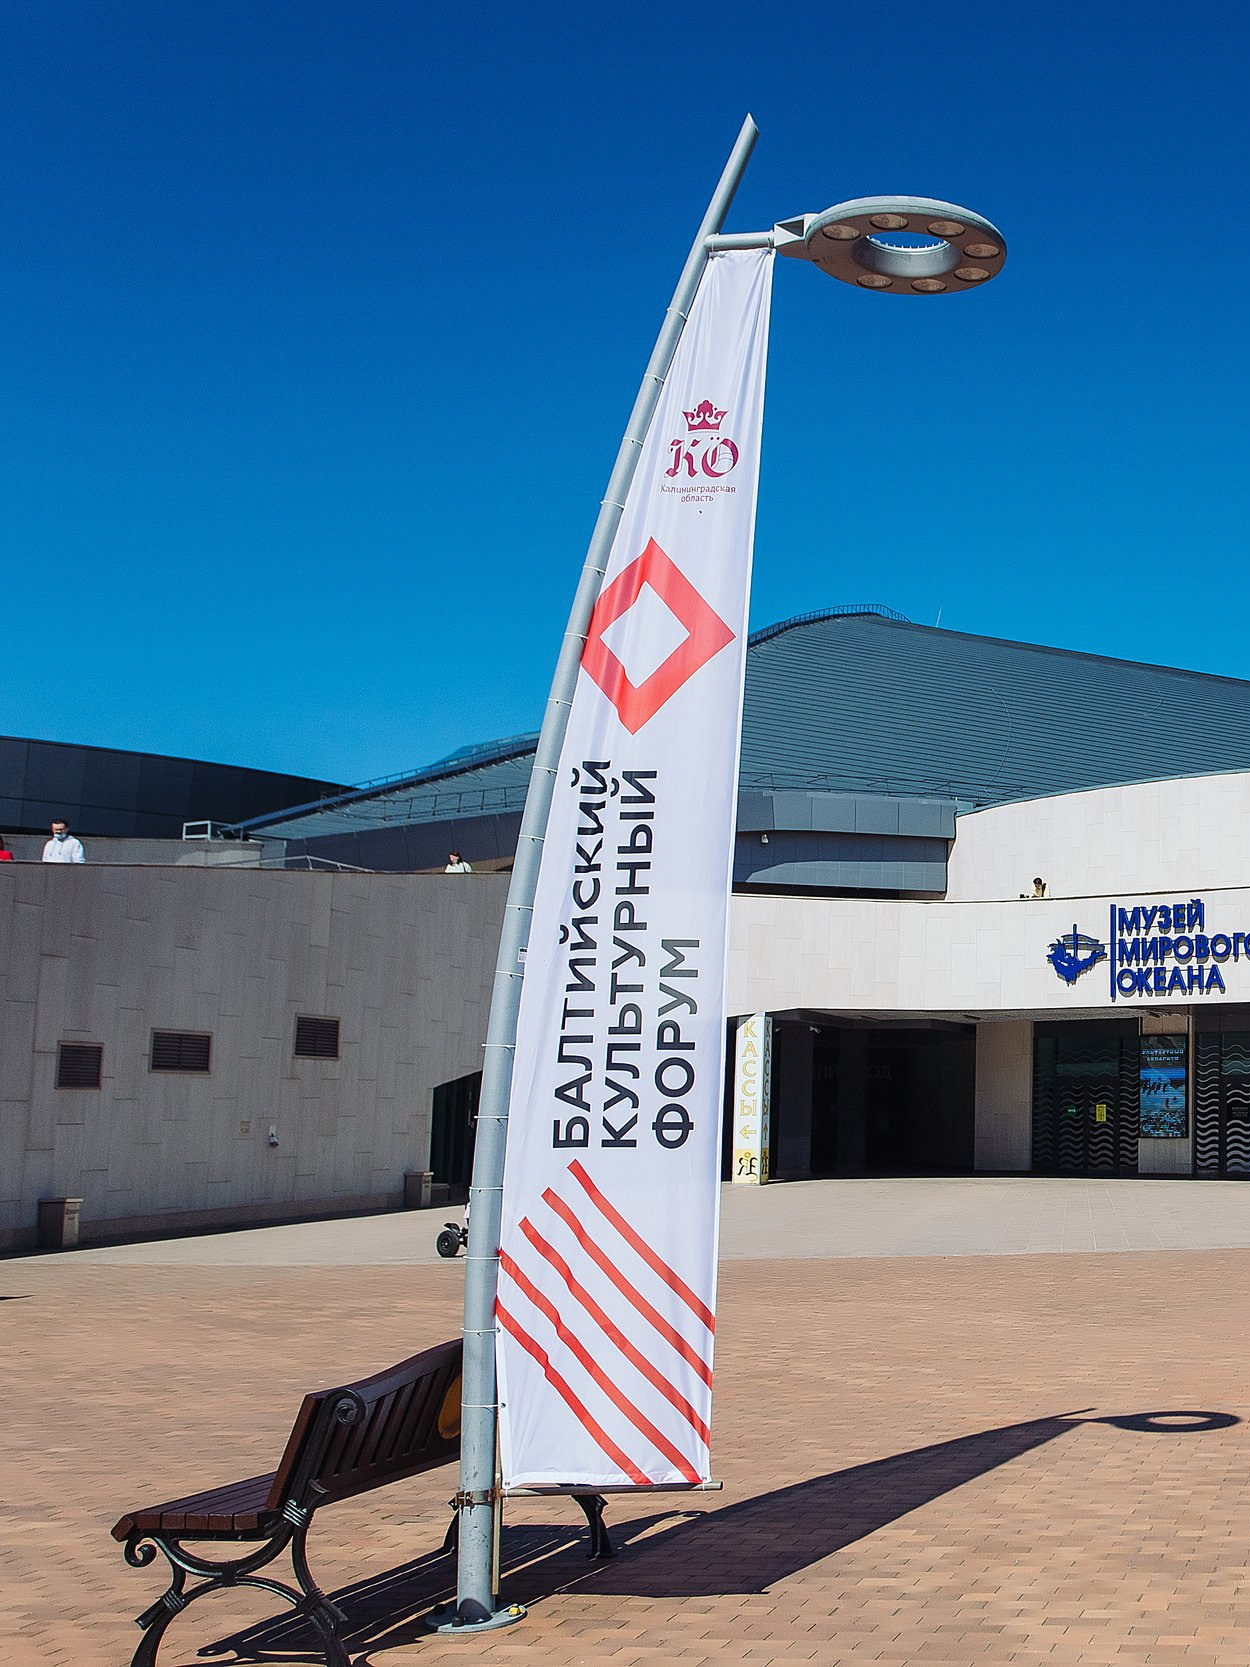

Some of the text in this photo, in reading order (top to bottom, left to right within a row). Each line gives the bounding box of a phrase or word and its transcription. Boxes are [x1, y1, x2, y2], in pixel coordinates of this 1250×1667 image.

[660, 484, 737, 494] Калининградская
[680, 494, 714, 502] область
[1118, 898, 1205, 934] МУЗЕЙ
[552, 760, 611, 1149] БАЛТИЙСКИЙ
[601, 770, 658, 1148] КУЛЬТУРНЫЙ
[1117, 964, 1226, 994] ОКЕАНА
[651, 938, 700, 1149] ФОРУМ
[739, 1021, 759, 1116] КАССЫ
